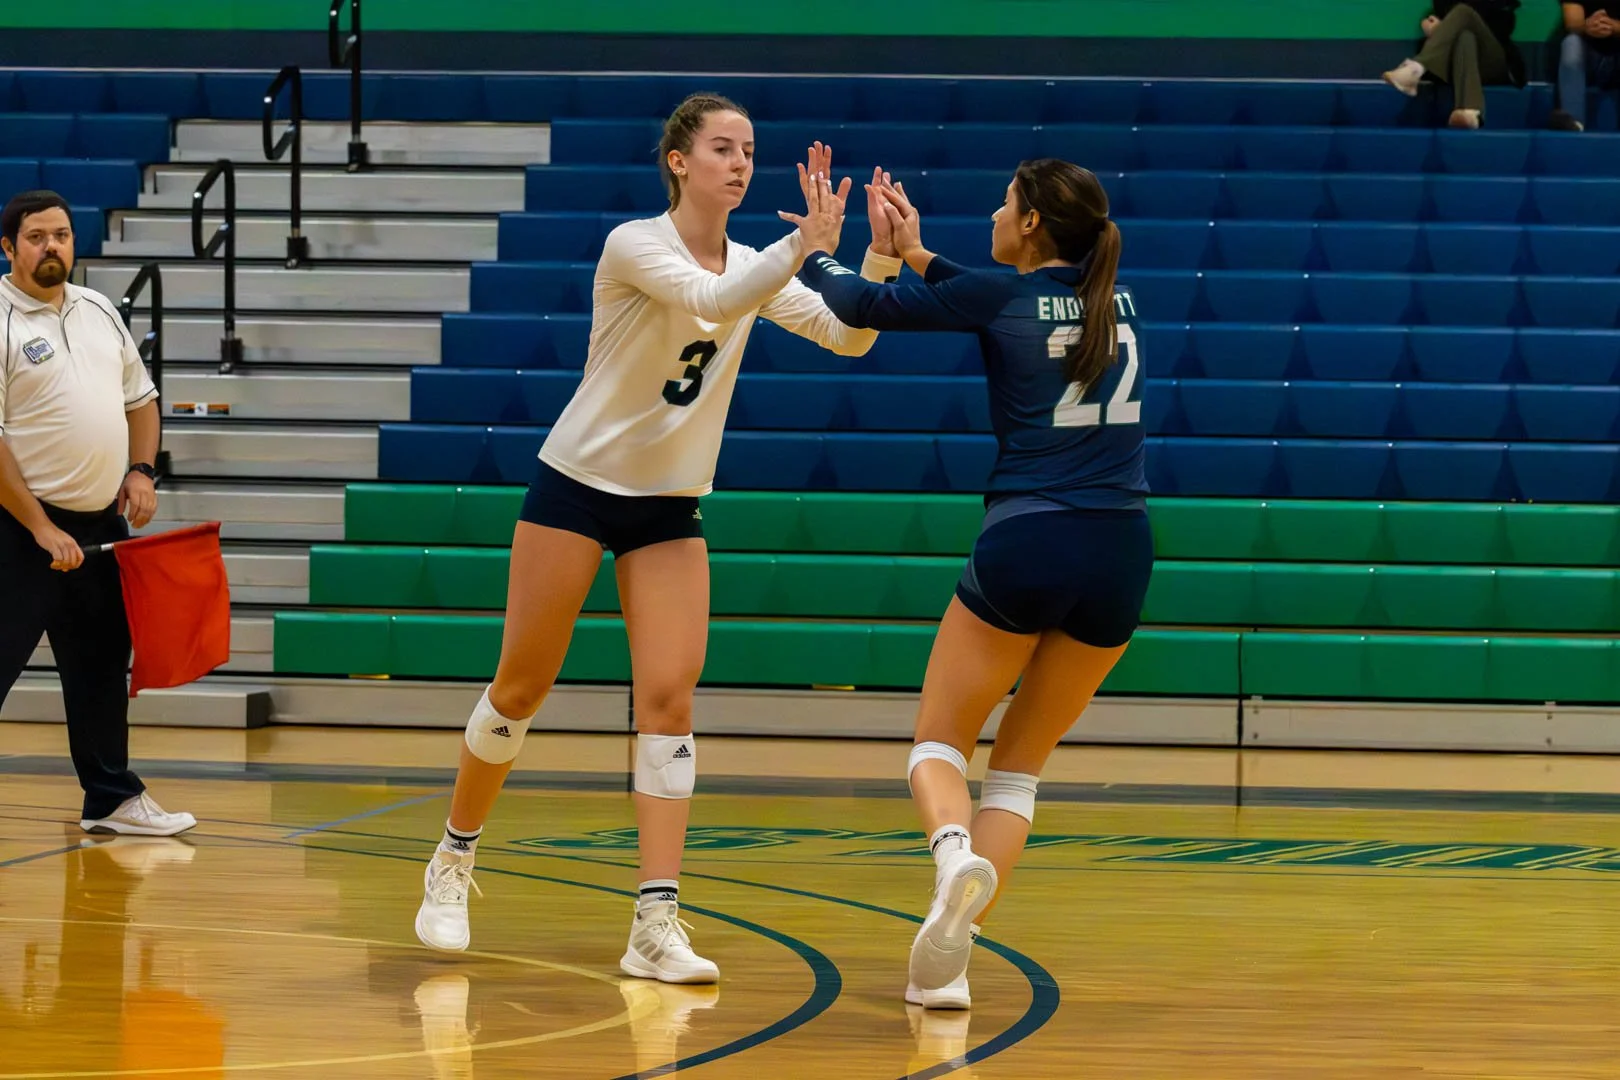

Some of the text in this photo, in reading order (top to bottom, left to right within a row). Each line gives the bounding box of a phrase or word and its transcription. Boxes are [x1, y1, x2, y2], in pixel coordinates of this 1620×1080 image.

[1038, 292, 1136, 320] ENDTT
[662, 339, 718, 407] 3
[1047, 324, 1141, 427] 22
